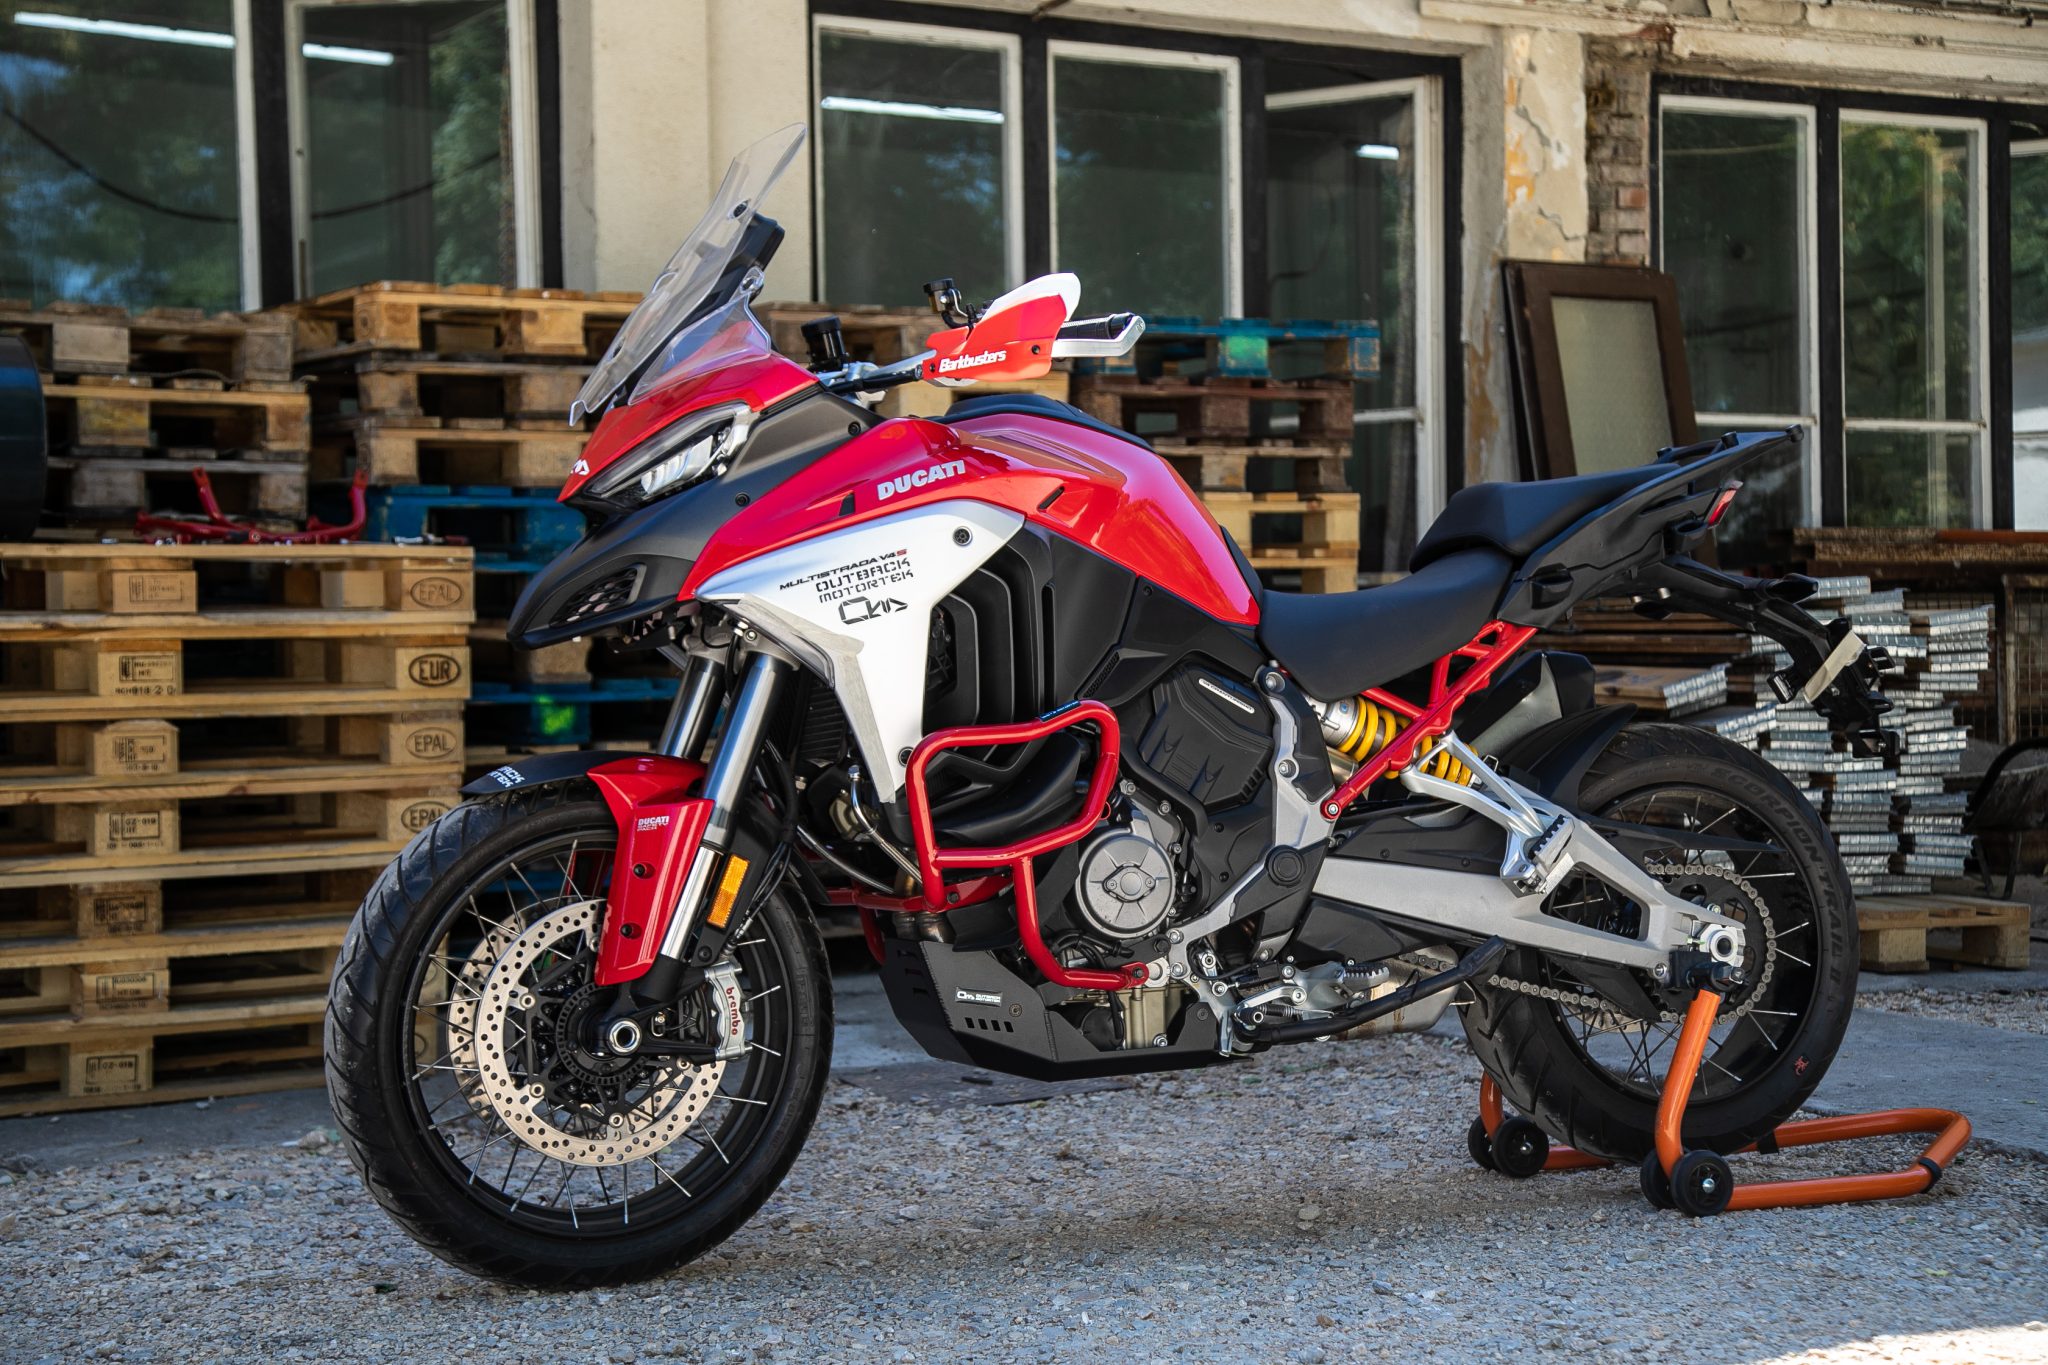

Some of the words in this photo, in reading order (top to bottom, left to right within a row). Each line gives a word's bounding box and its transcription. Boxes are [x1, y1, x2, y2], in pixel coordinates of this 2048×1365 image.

[939, 351, 1007, 373] Barkbusters
[877, 460, 966, 501] DUCATI
[779, 557, 878, 591] MULTISTRADA
[815, 557, 911, 593] OUTBACK
[819, 569, 914, 604] MOTORTEK
[419, 582, 454, 601] EPAL
[418, 660, 450, 681] EUR
[414, 735, 450, 751] EPAL
[637, 815, 670, 826] DUCATI
[1710, 766, 1824, 863] SCORPION
[726, 986, 742, 1036] brembo
